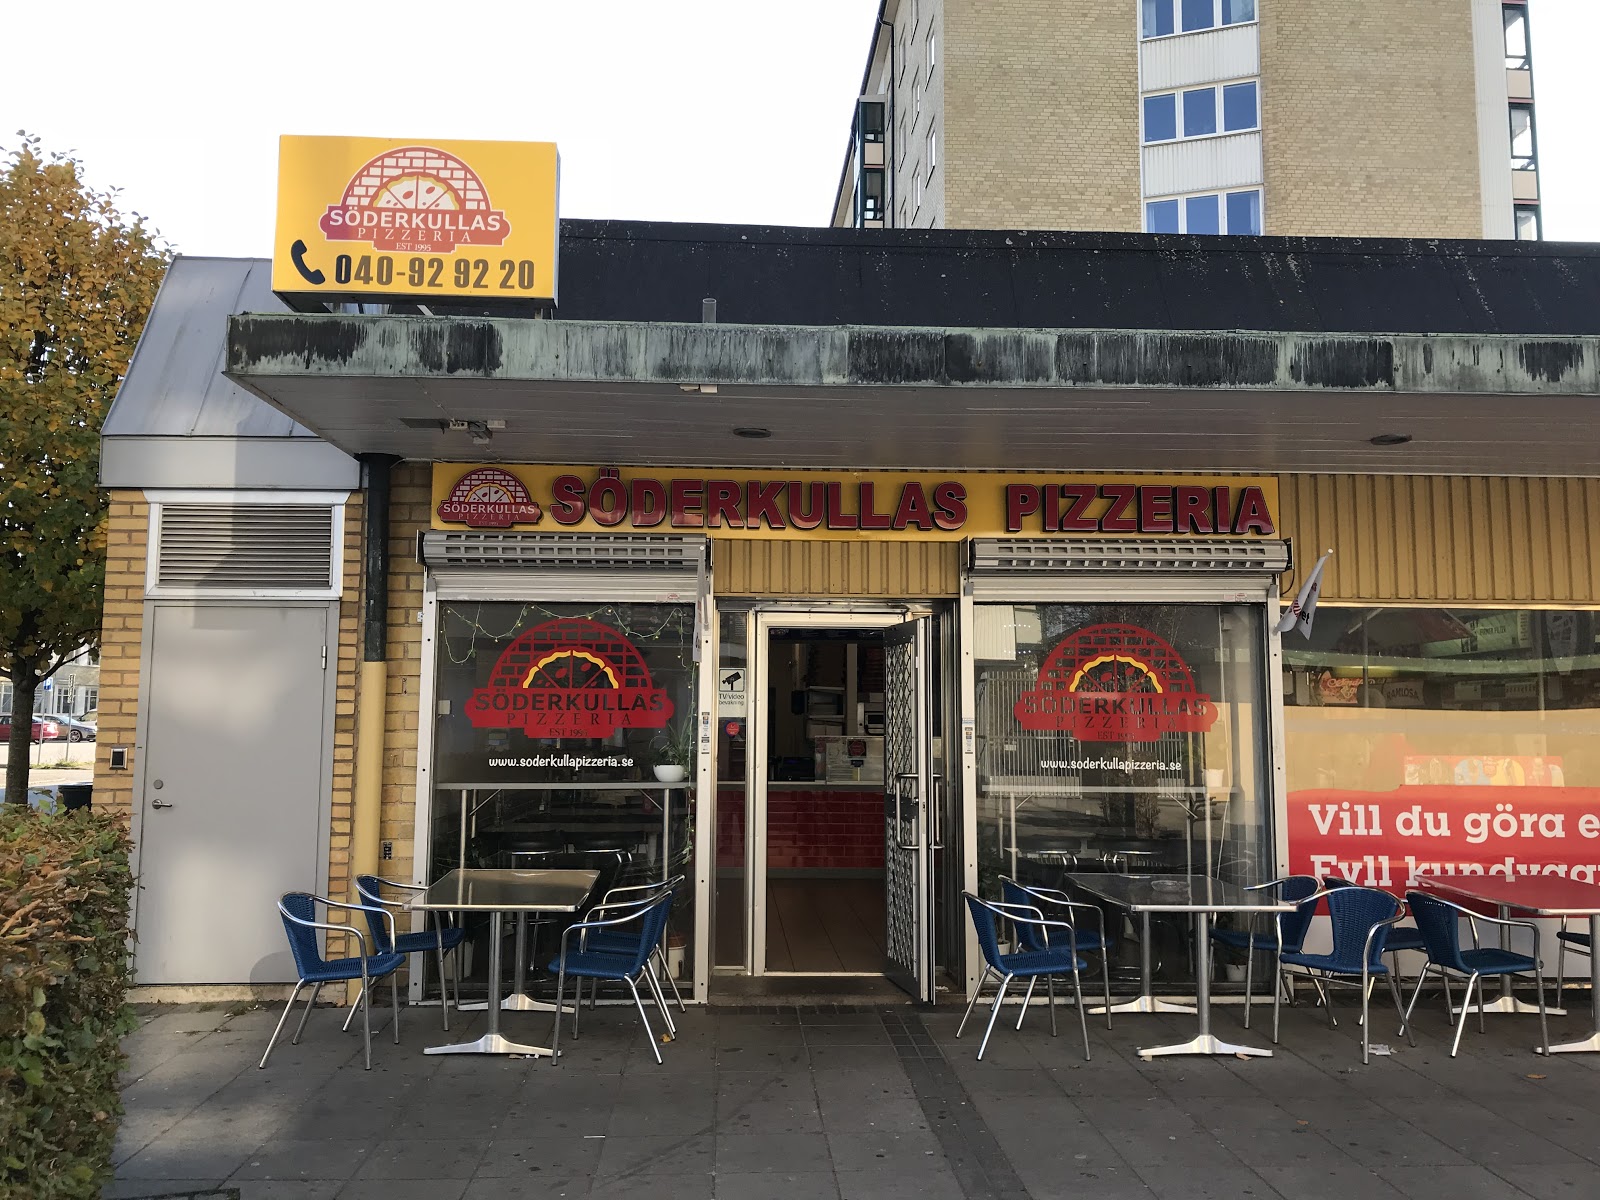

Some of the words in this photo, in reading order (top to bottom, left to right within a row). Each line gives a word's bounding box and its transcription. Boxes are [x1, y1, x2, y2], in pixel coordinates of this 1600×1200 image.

[329, 207, 501, 231] SÖDERKULLAS
[357, 227, 472, 243] PIZZERIA
[396, 243, 412, 251] EST
[415, 244, 432, 252] 1995
[335, 254, 444, 288] 040-92
[454, 258, 489, 289] 92
[499, 259, 535, 290] 20
[443, 502, 535, 514] SÖDERKULLAS
[550, 467, 968, 530] SÖDERKULLAS
[1006, 484, 1276, 534] PIZZERIA
[458, 513, 520, 521] PIZZERIA
[475, 689, 664, 712] SÖDERKULLAS
[1024, 692, 1207, 716] SÖDERKULLAS
[507, 712, 632, 726] PIZZERIA
[1056, 716, 1177, 729] PIZZERIA
[549, 728, 566, 736] EST
[1097, 731, 1114, 740] EST
[489, 754, 634, 771] www.soderkullapizzeria.se
[1040, 757, 1182, 774] www.soderkullapizzeria.se
[1308, 801, 1383, 836] Vill
[1395, 805, 1451, 837] du
[1463, 803, 1566, 844] göra
